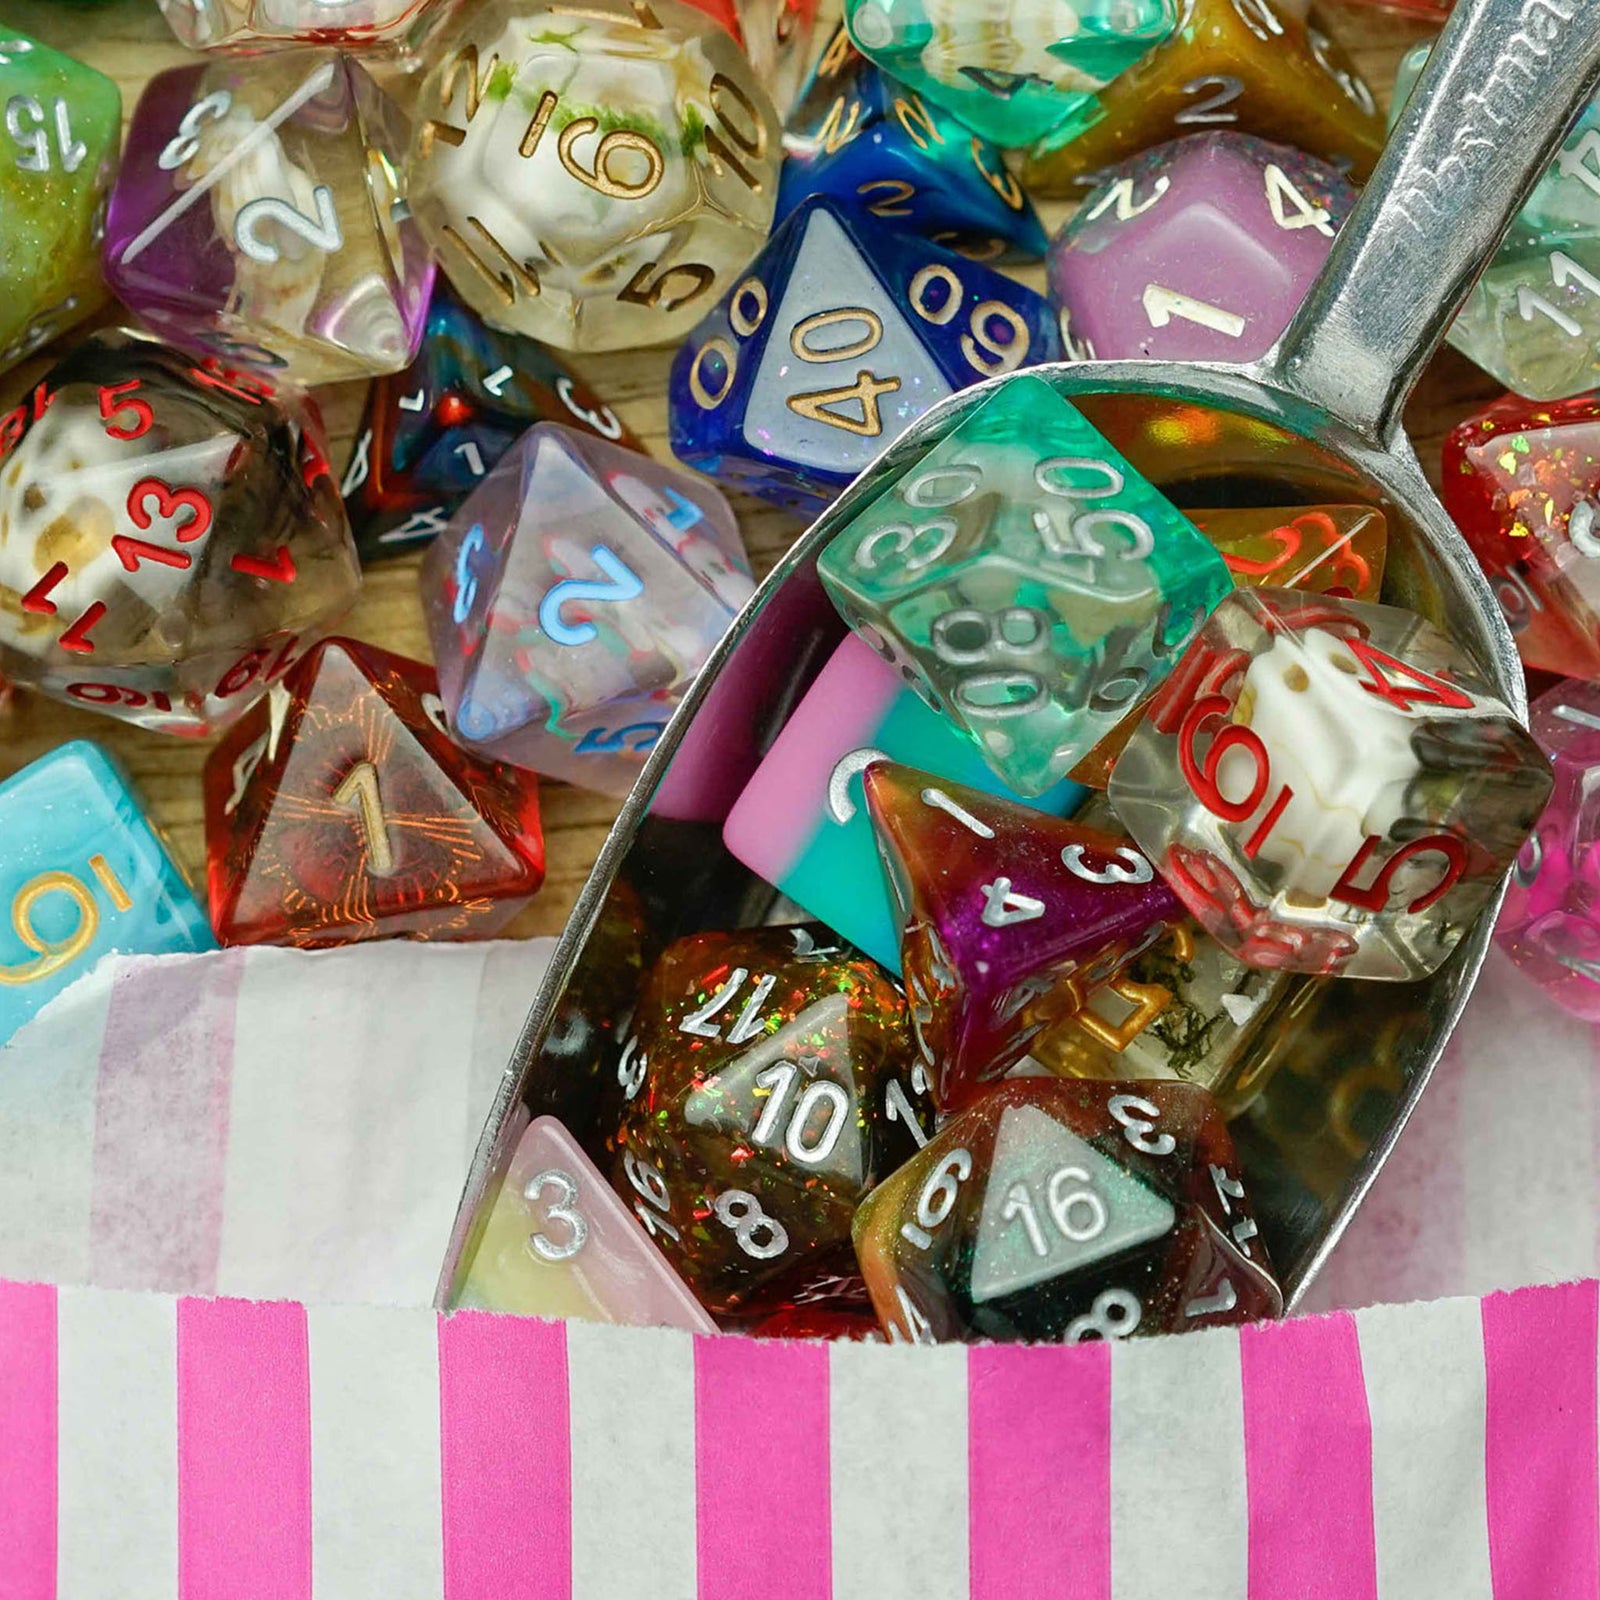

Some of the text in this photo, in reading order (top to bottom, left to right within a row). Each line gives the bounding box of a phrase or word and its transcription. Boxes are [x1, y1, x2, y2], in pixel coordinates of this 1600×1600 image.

[7, 94, 87, 172] 15
[159, 90, 232, 170] 3
[1174, 75, 1245, 124] 2
[234, 184, 343, 263] 2
[857, 180, 915, 217] 2
[1264, 164, 1335, 237] 4
[616, 262, 716, 313] 5
[1142, 283, 1246, 338] 1
[97, 378, 155, 442] 5
[786, 306, 901, 437] 40
[111, 474, 213, 573] 13
[538, 543, 645, 647] 2
[1343, 636, 1476, 712] 4
[332, 760, 392, 876] 1
[980, 876, 1046, 928] 4
[1061, 843, 1155, 884] 3
[1328, 833, 1468, 915] 5
[752, 1056, 849, 1164] 10
[1108, 1095, 1176, 1155] 3
[523, 1168, 589, 1261] 3
[714, 1189, 789, 1259] 8
[1002, 1166, 1109, 1257] 16
